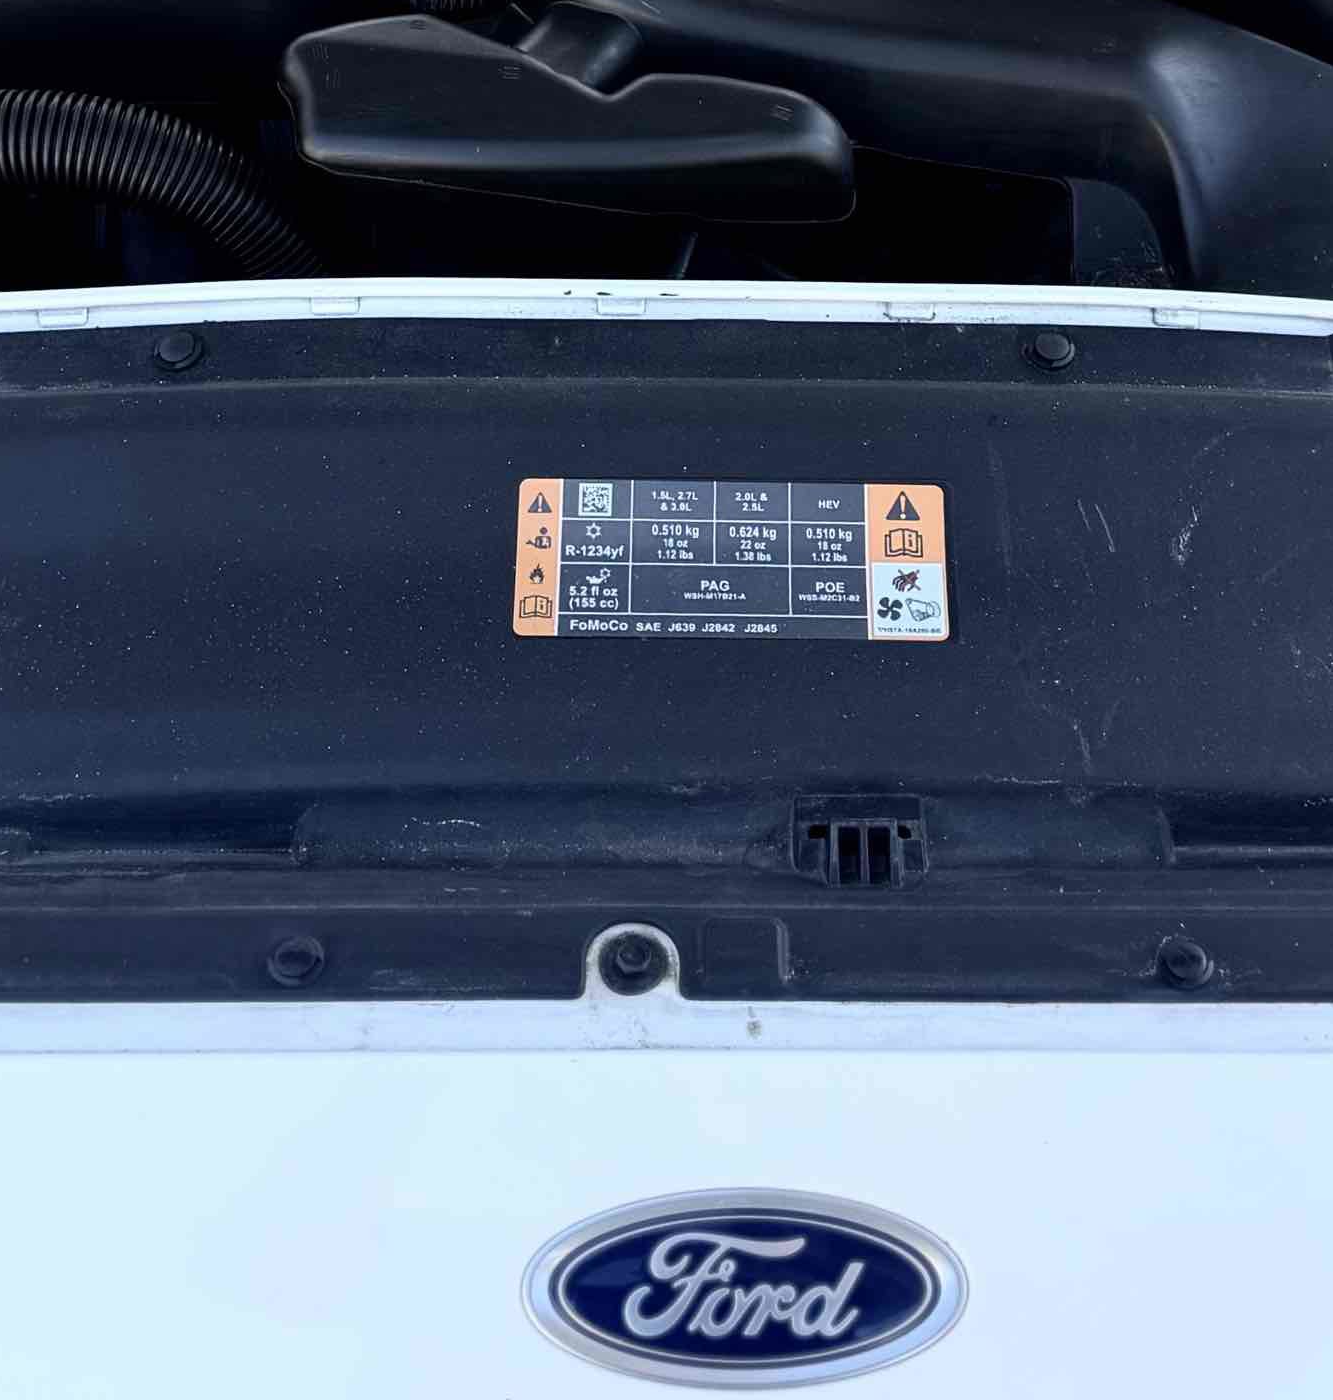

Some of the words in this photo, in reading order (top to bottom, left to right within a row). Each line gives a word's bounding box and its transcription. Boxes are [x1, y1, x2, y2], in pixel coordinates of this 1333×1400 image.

[677, 491, 699, 501] 2.7L
[735, 492, 757, 501] 2.0L
[760, 492, 768, 501] &
[660, 502, 668, 511] &
[742, 502, 765, 512] 2.5L
[818, 499, 841, 509] HEV
[651, 524, 682, 536] 0.510
[685, 524, 700, 539] kg
[729, 526, 759, 538] 0.624
[763, 526, 777, 541] kg
[806, 527, 836, 539] 0.510
[838, 527, 853, 542] kg
[663, 538, 674, 548] 18
[676, 540, 689, 548] oz
[740, 540, 752, 550] 22
[754, 541, 766, 550] oz
[817, 541, 828, 551] 18
[830, 542, 842, 551] oz
[565, 544, 625, 560] R-1234yf
[657, 550, 677, 560] 1.12
[679, 549, 694, 560] lbs
[735, 551, 754, 561] 1.38
[756, 551, 772, 561] lbs
[811, 552, 831, 562] 1.12
[833, 552, 848, 562] lbs
[569, 585, 588, 597] 5.2
[591, 585, 600, 597] fl
[602, 587, 619, 597] oz
[700, 580, 731, 592] PAG
[815, 581, 846, 593] POE
[569, 597, 596, 611] (155
[599, 597, 619, 611] cc)
[569, 619, 629, 631] FoMoCo
[635, 622, 662, 632] SAE
[701, 623, 736, 633] J2842
[744, 623, 778, 633] J2845
[625, 1232, 865, 1338] Ford
